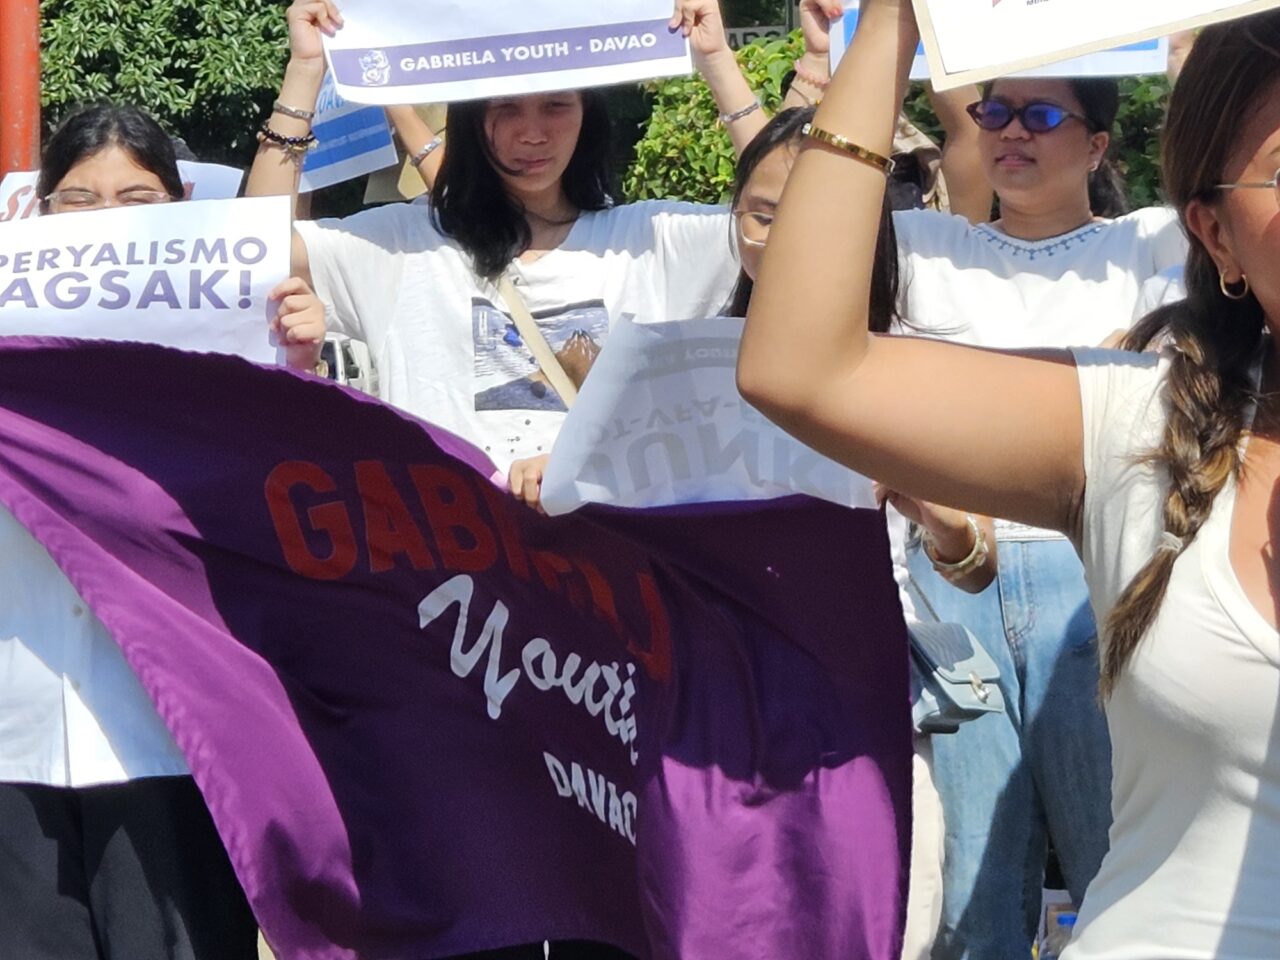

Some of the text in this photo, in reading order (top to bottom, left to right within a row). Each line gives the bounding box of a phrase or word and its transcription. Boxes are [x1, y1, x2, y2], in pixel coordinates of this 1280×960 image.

[399, 48, 495, 74] GABRIELA
[500, 40, 570, 66] YOUTH
[589, 32, 657, 55] DAVAO
